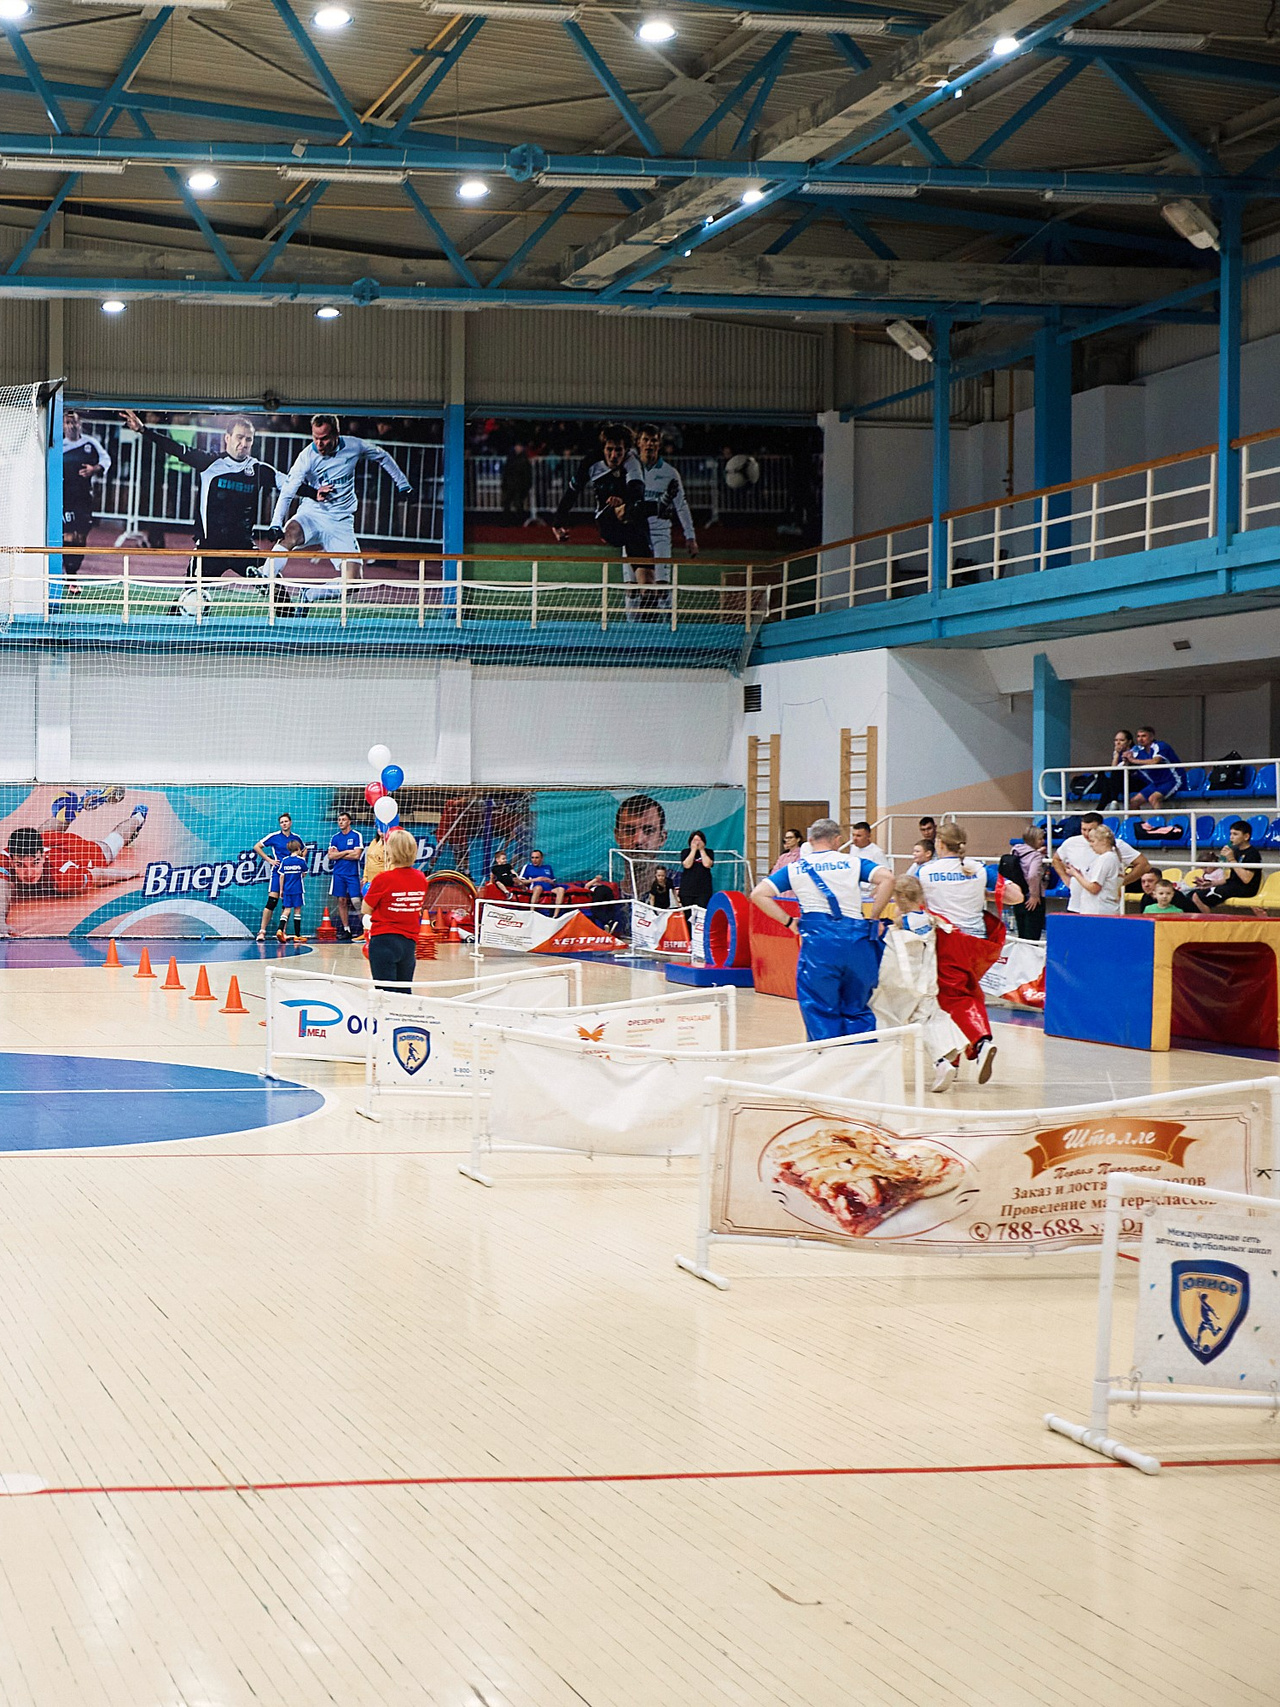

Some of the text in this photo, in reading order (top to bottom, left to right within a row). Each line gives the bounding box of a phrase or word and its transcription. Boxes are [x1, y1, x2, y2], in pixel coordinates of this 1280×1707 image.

[1063, 1128, 1156, 1149] Штолле
[1011, 1186, 1052, 1200] Заказ
[1066, 1180, 1108, 1194] доста
[1001, 1199, 1087, 1219] Проведение
[996, 1217, 1084, 1240] 788-688
[1167, 1227, 1240, 1241] Международная
[1182, 1277, 1238, 1297] ЮНИОР
